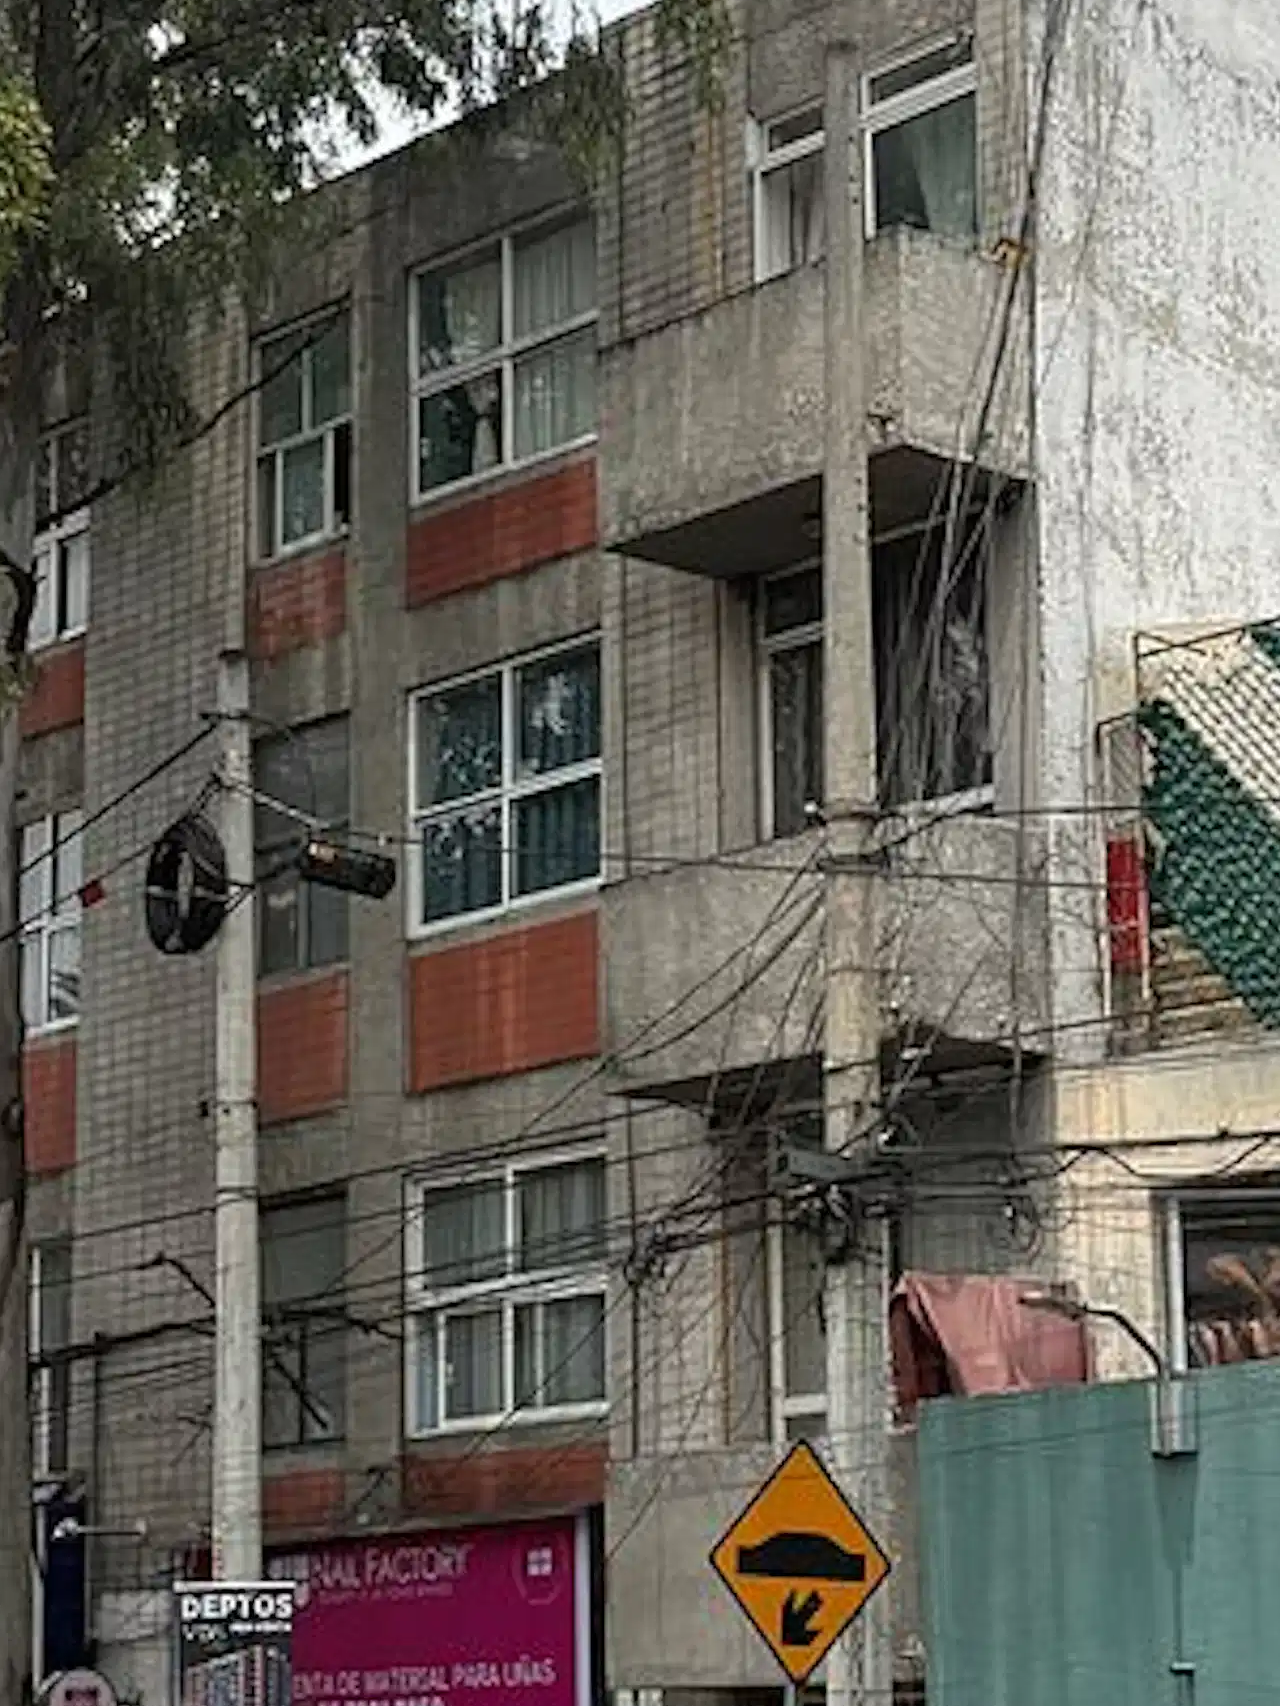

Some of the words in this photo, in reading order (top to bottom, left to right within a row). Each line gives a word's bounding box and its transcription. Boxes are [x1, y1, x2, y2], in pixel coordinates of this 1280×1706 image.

[365, 1543, 471, 1582] FACTORY
[180, 1593, 293, 1620] DEPTOS
[293, 1669, 334, 1699] ENTA
[336, 1670, 360, 1696] DE
[363, 1665, 450, 1695] MATERIAL
[452, 1662, 500, 1688] PARA
